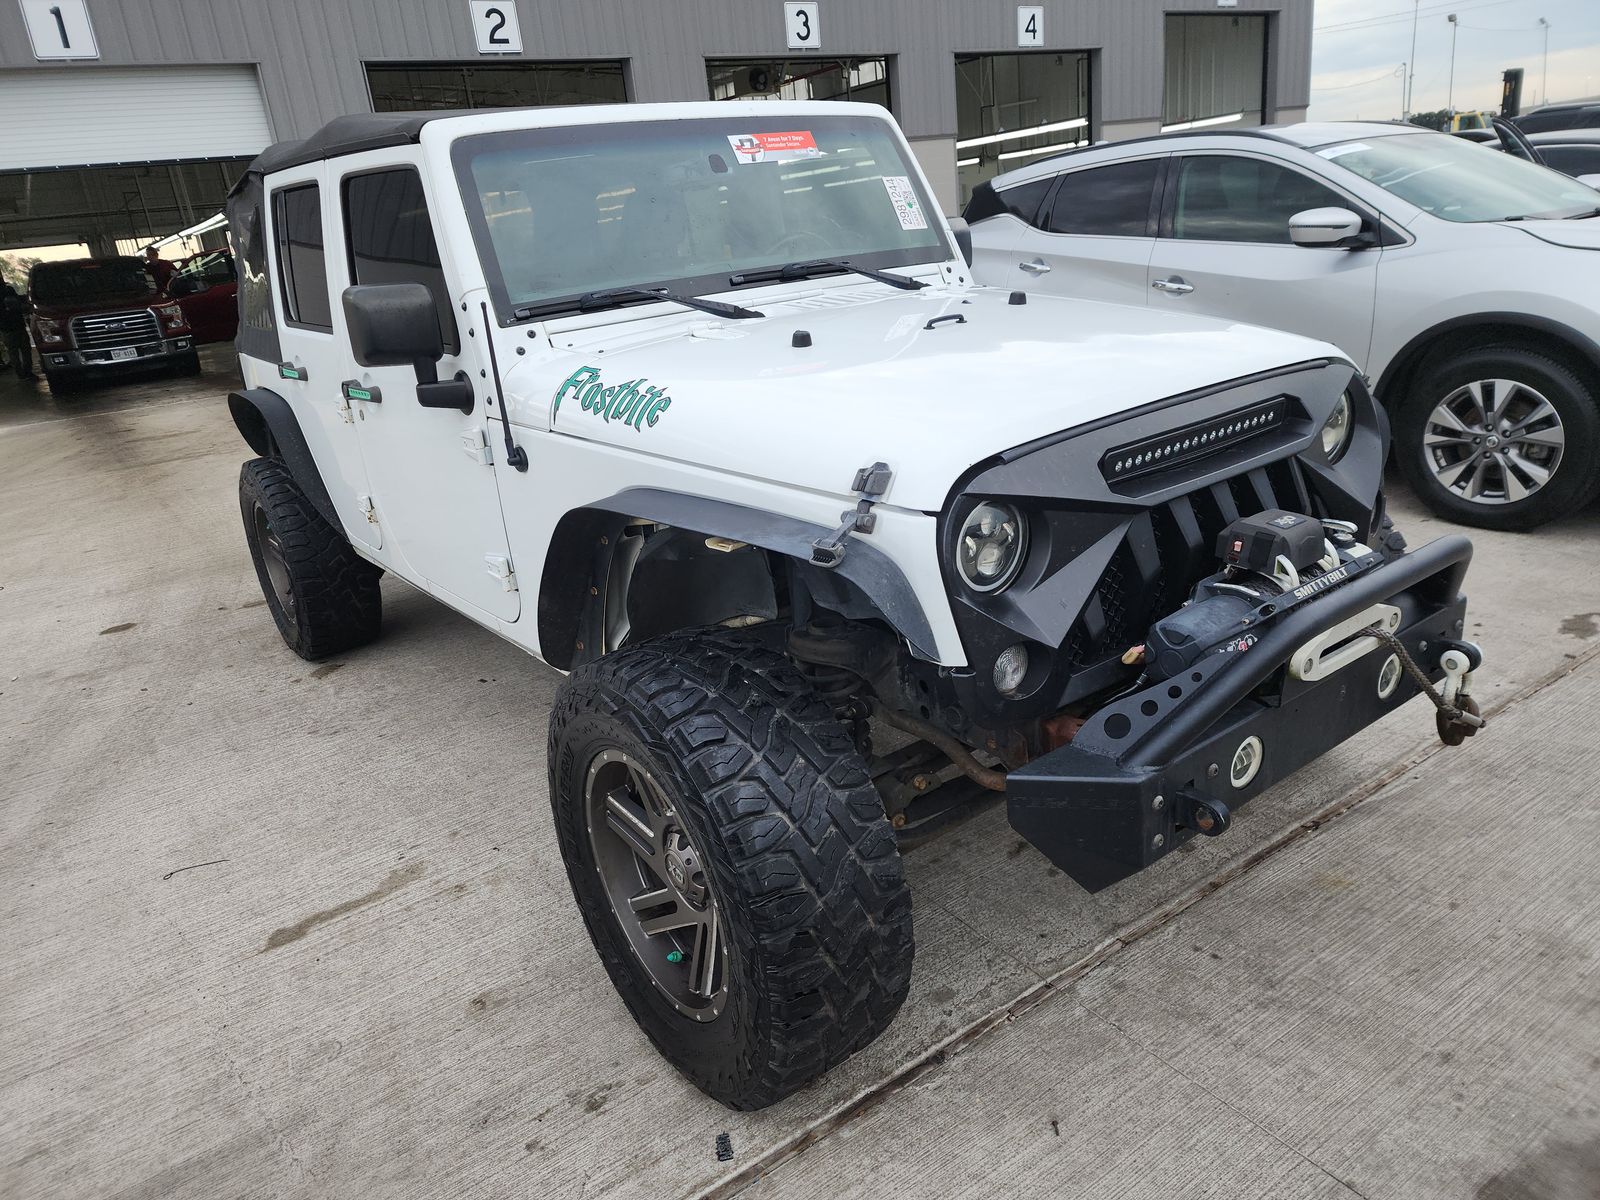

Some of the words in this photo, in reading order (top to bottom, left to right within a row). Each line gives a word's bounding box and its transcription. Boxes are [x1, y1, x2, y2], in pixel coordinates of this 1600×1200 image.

[49, 6, 71, 49] 1
[485, 7, 510, 45] 2
[795, 9, 811, 41] 3
[1024, 13, 1038, 40] 4
[885, 178, 912, 225] 2981244
[553, 365, 672, 433] Frostbite
[1293, 566, 1348, 600] SMITTYBILT
